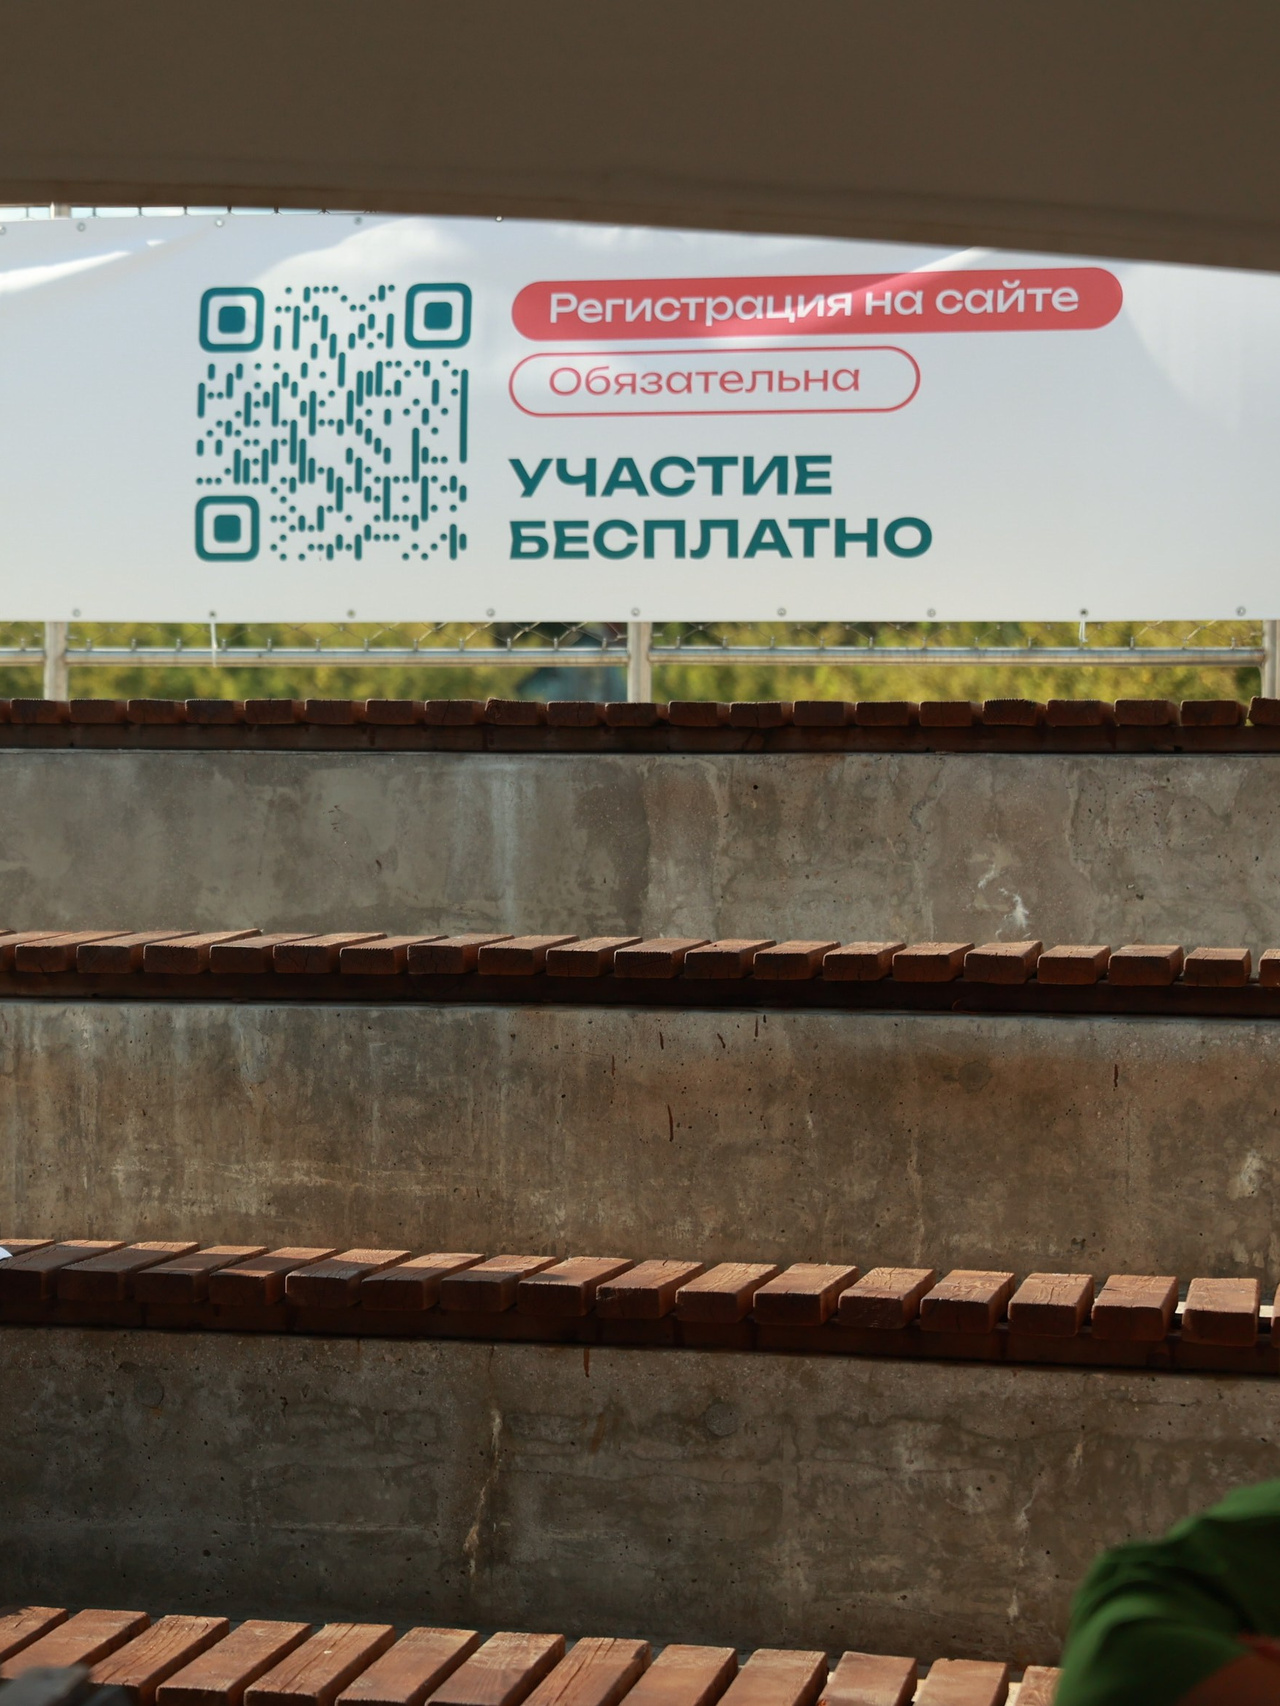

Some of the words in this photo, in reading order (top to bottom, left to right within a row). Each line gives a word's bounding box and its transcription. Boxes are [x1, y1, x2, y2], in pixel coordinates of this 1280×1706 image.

[549, 292, 853, 327] Регистрация
[865, 289, 923, 316] на
[935, 280, 1080, 315] сайте
[548, 366, 861, 397] Обязательна
[508, 454, 833, 498] УЧАСТИЕ
[509, 516, 933, 560] БЕСПЛАТНО
